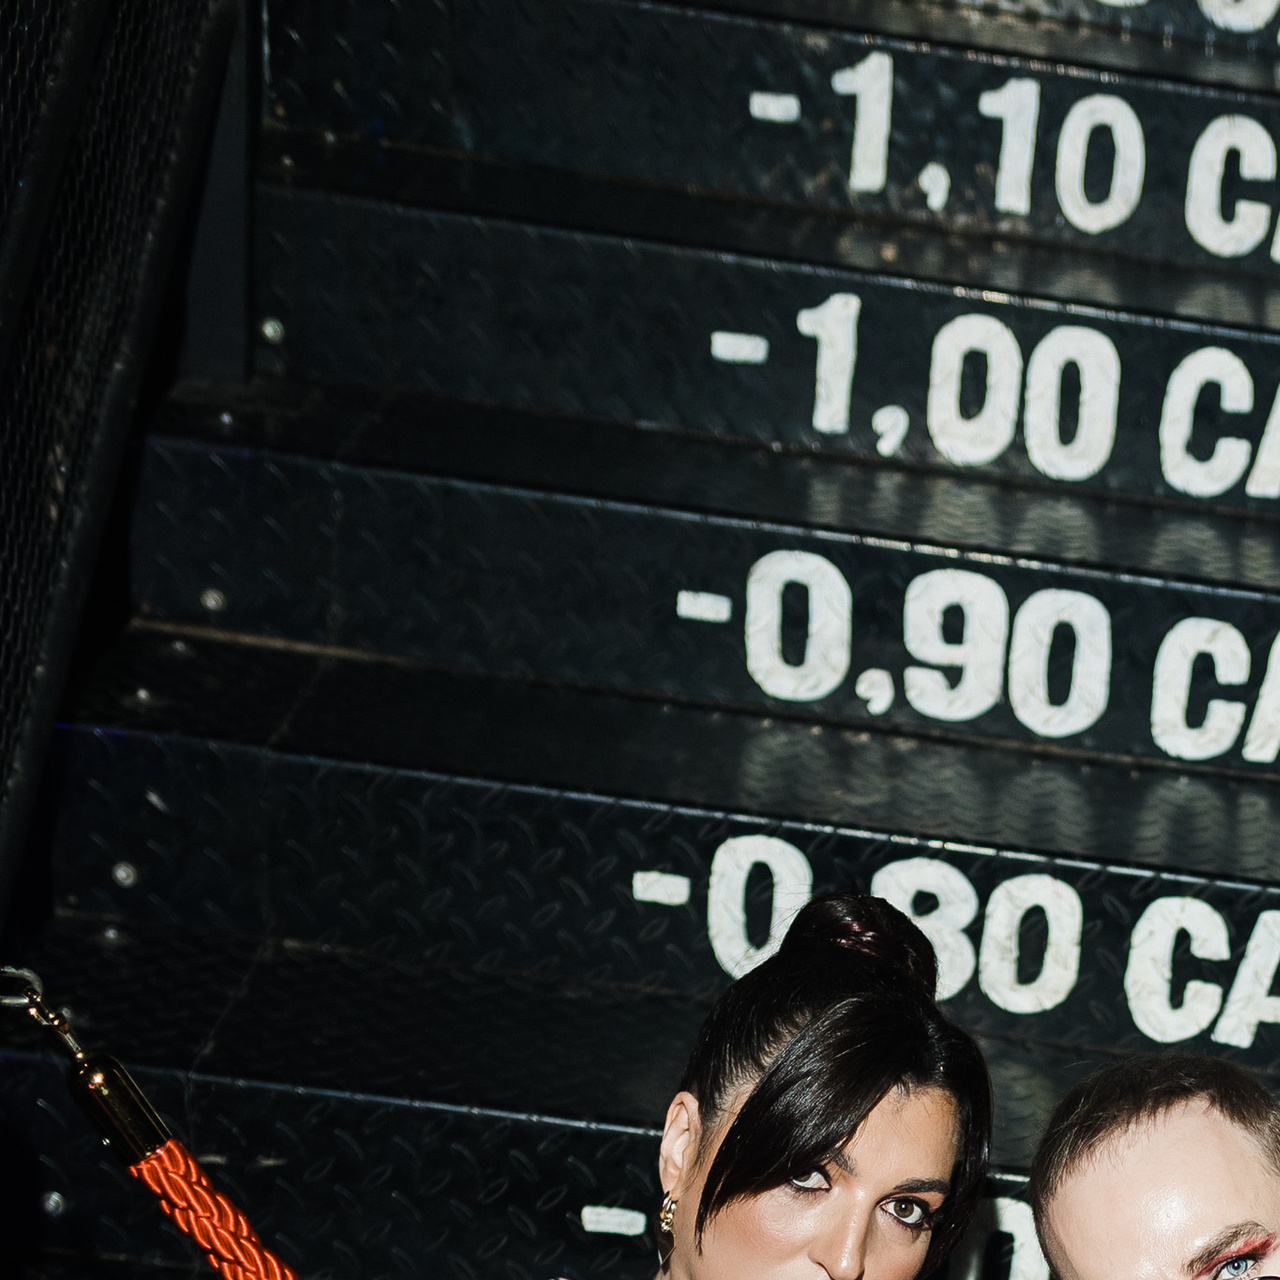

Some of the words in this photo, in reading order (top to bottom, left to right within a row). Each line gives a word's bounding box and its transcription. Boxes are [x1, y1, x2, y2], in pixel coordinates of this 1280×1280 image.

[749, 51, 1146, 234] -1,10
[711, 293, 1121, 481] -1,00
[676, 549, 1112, 738] -0,90
